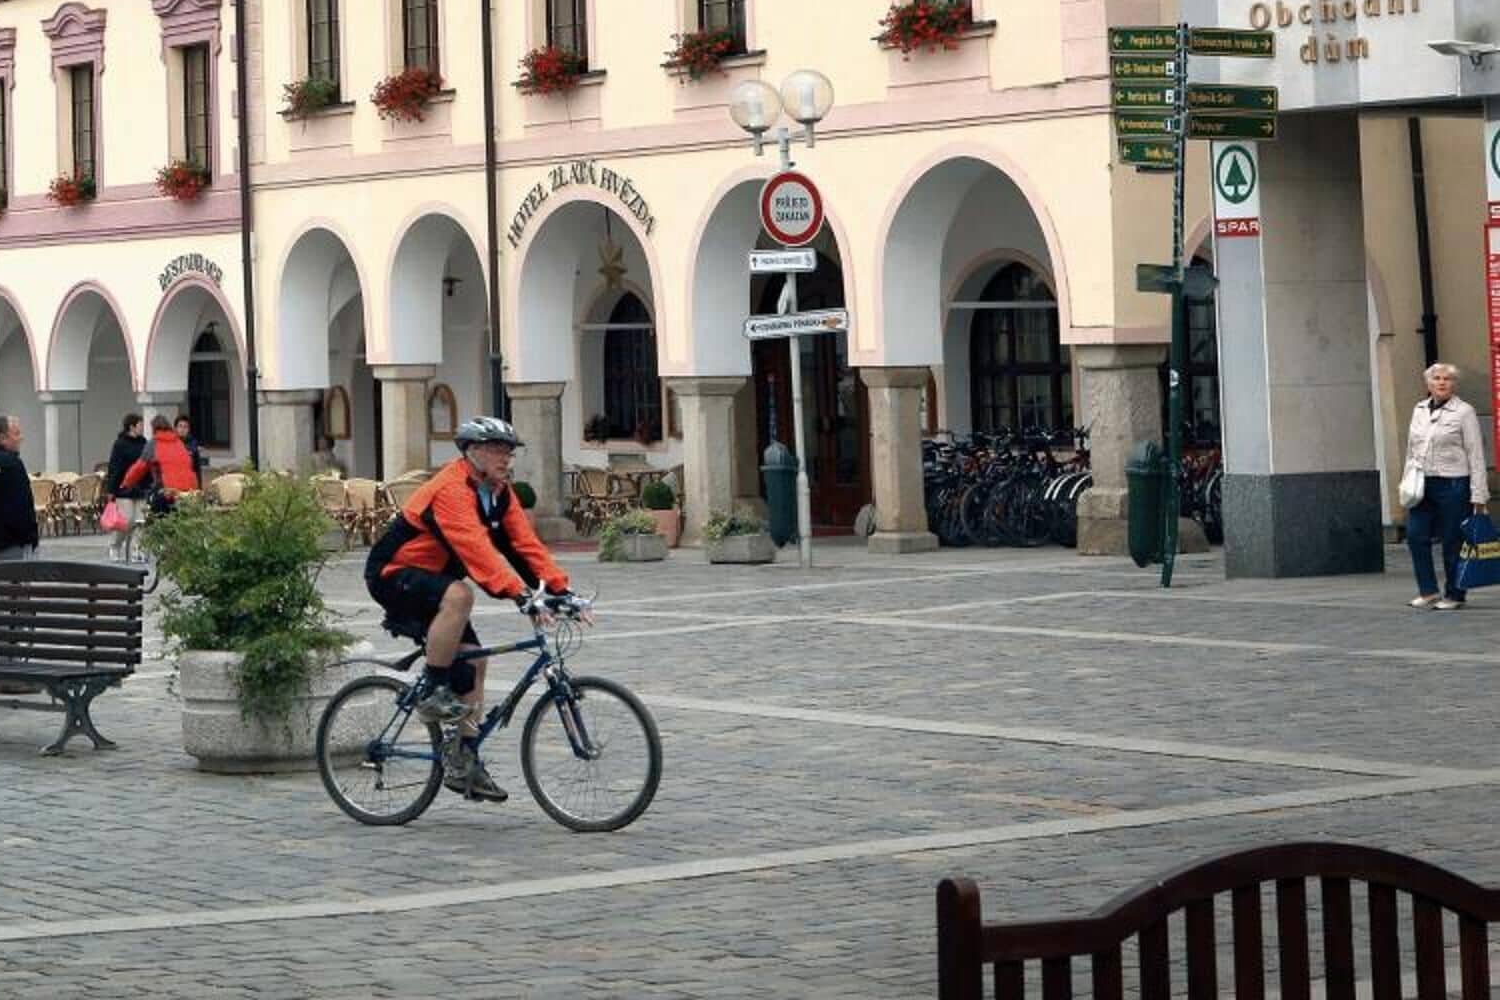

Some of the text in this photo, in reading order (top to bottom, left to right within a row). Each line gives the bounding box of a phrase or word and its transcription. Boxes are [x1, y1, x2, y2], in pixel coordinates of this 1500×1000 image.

[1300, 32, 1370, 64] dům
[507, 181, 549, 249] HOTEL
[1217, 220, 1260, 234] SPAR
